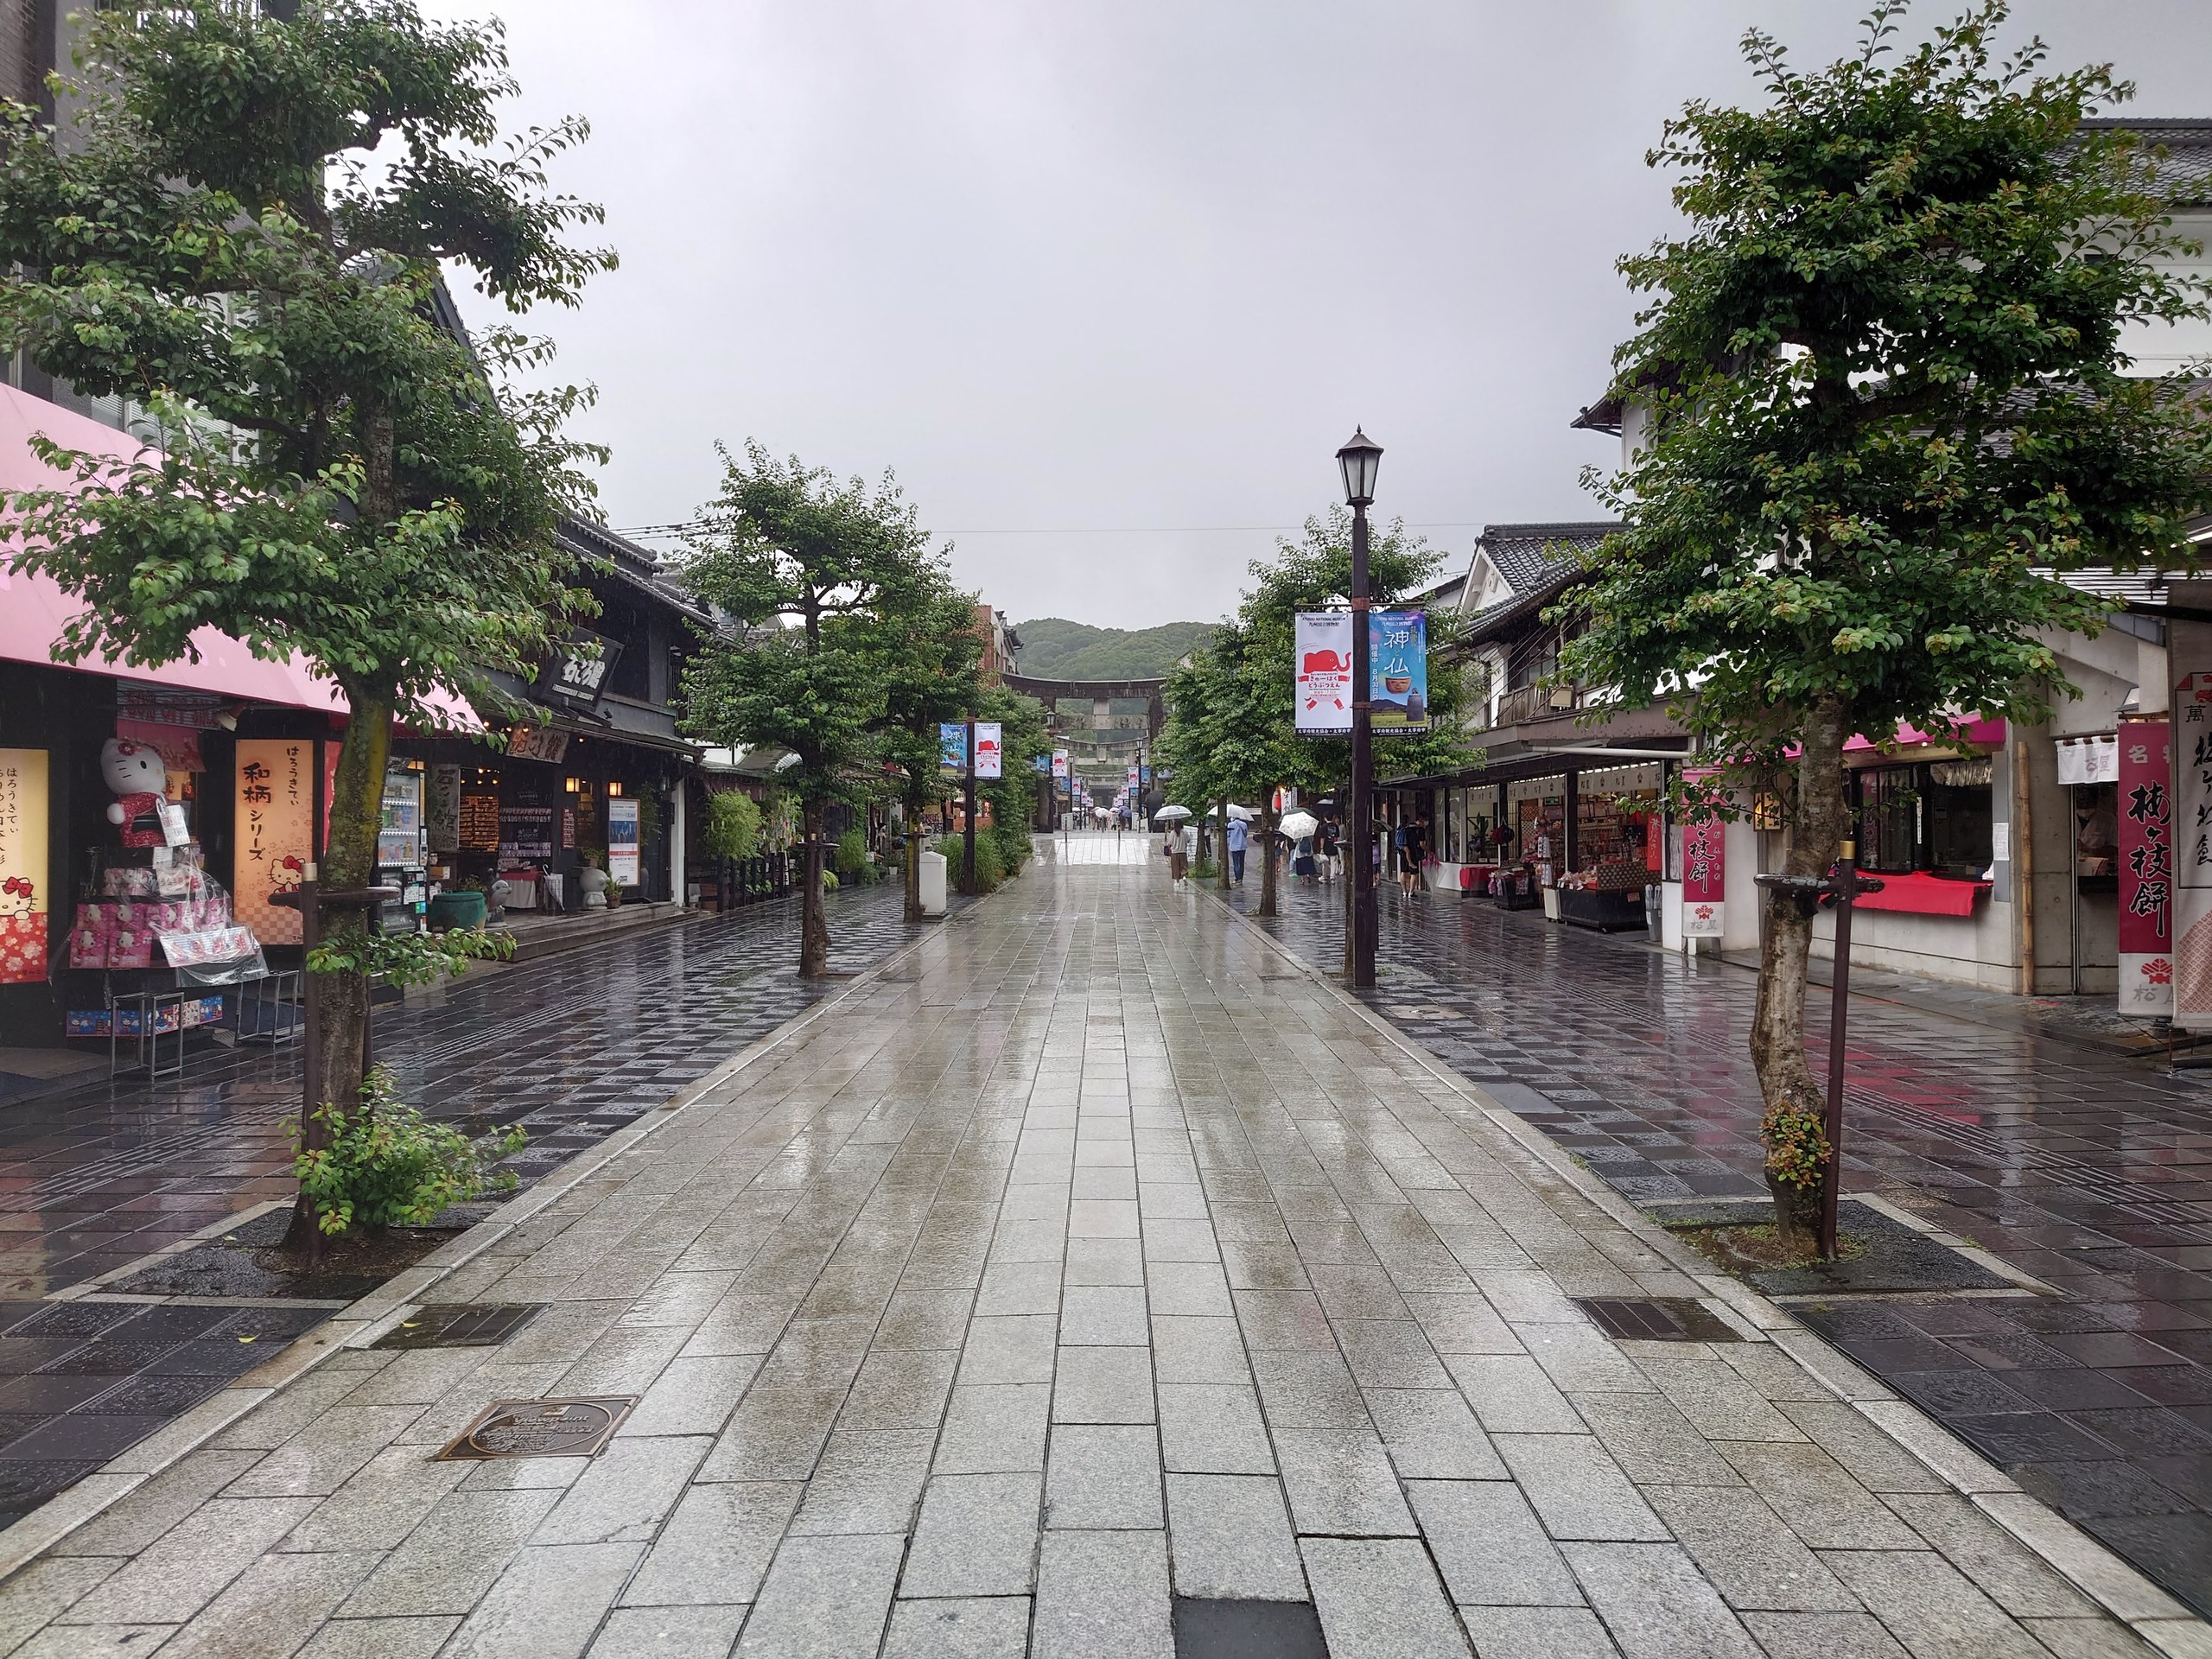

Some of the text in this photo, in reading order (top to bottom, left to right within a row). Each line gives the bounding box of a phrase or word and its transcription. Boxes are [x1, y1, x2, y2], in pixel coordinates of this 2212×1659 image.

[7, 768, 18, 834] はろうきてい
[287, 747, 299, 805] はろうきてい
[243, 762, 271, 861] 和柄シリーズ
[516, 1415, 589, 1424] Viewpoint
